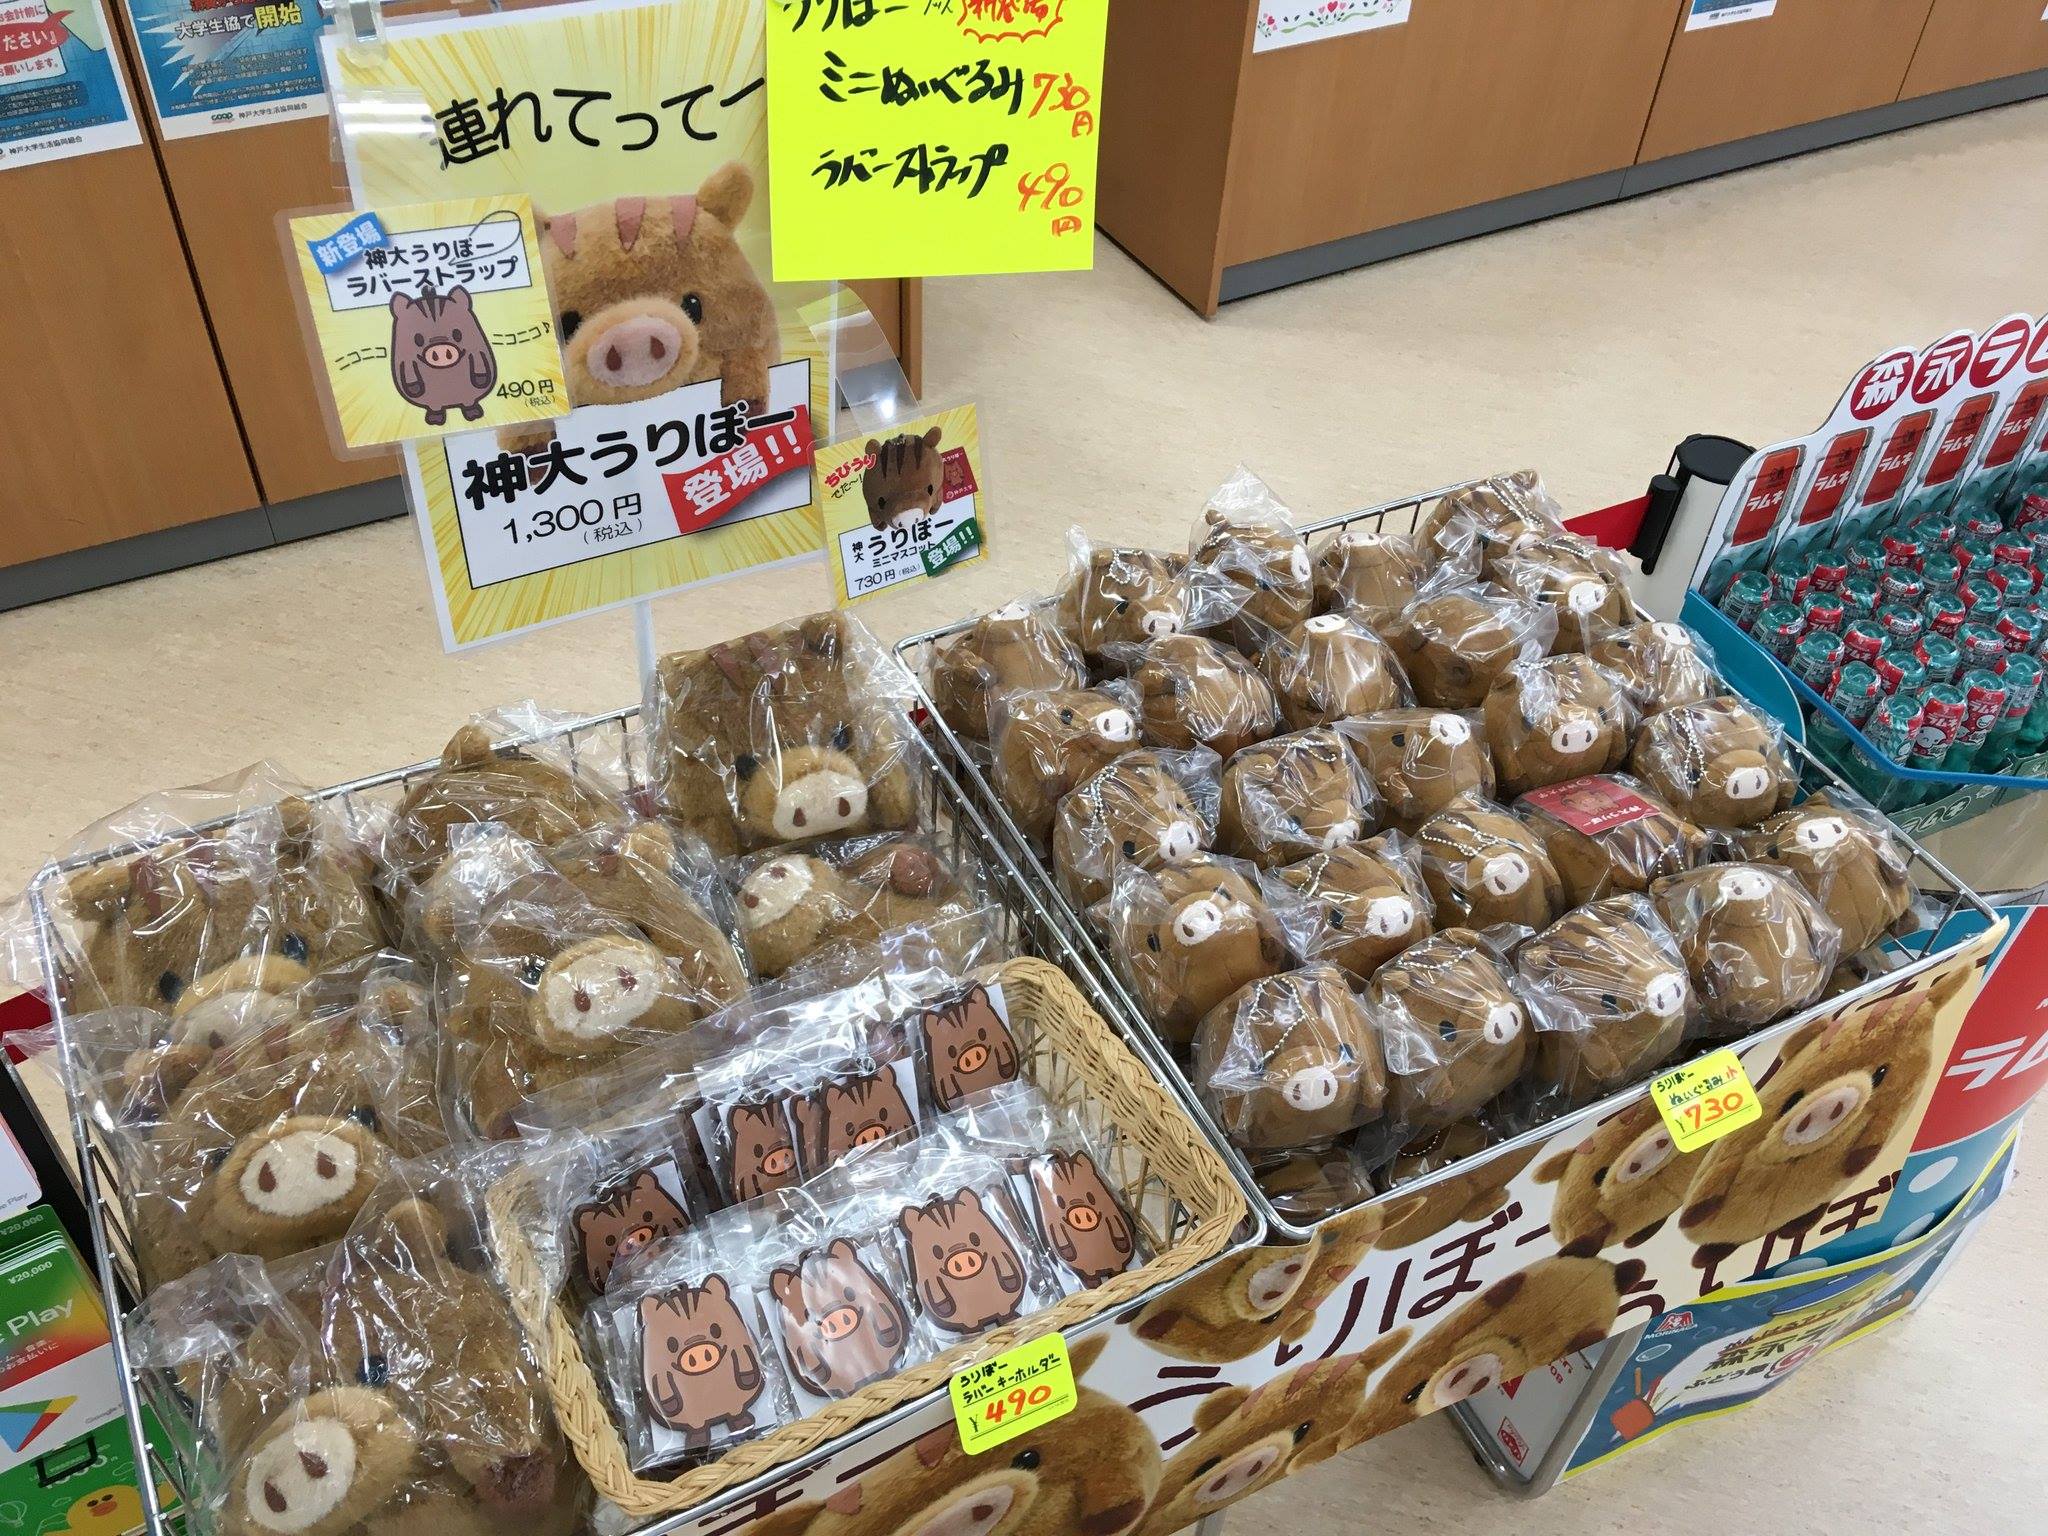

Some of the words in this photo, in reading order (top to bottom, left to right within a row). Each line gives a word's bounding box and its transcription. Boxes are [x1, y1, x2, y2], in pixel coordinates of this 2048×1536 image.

[819, 50, 1024, 116] ミニぬいぐるみ
[1028, 72, 1091, 119] 730
[437, 78, 765, 169] 連れてってー
[1071, 110, 1094, 138] 円
[811, 143, 1009, 199] ラバーストラップ
[1018, 162, 1084, 212] 490
[316, 220, 382, 267] 新登場
[1051, 215, 1082, 237] 円
[364, 237, 495, 270] 神大うりぼー
[347, 256, 518, 297] ラバーストラップ
[462, 398, 799, 511] 神大うりぼー
[824, 452, 877, 488] ちびうり
[868, 519, 954, 556] うりぼー
[872, 541, 936, 568] ミニマスコット
[1657, 1072, 1694, 1092] うりぼー
[1669, 1076, 1723, 1106] ぬいぐるみ
[7, 1298, 74, 1337] Play
[960, 1361, 1008, 1388] うりぼー
[963, 1384, 994, 1404] ラバー
[997, 1353, 1061, 1388] キーホルダー
